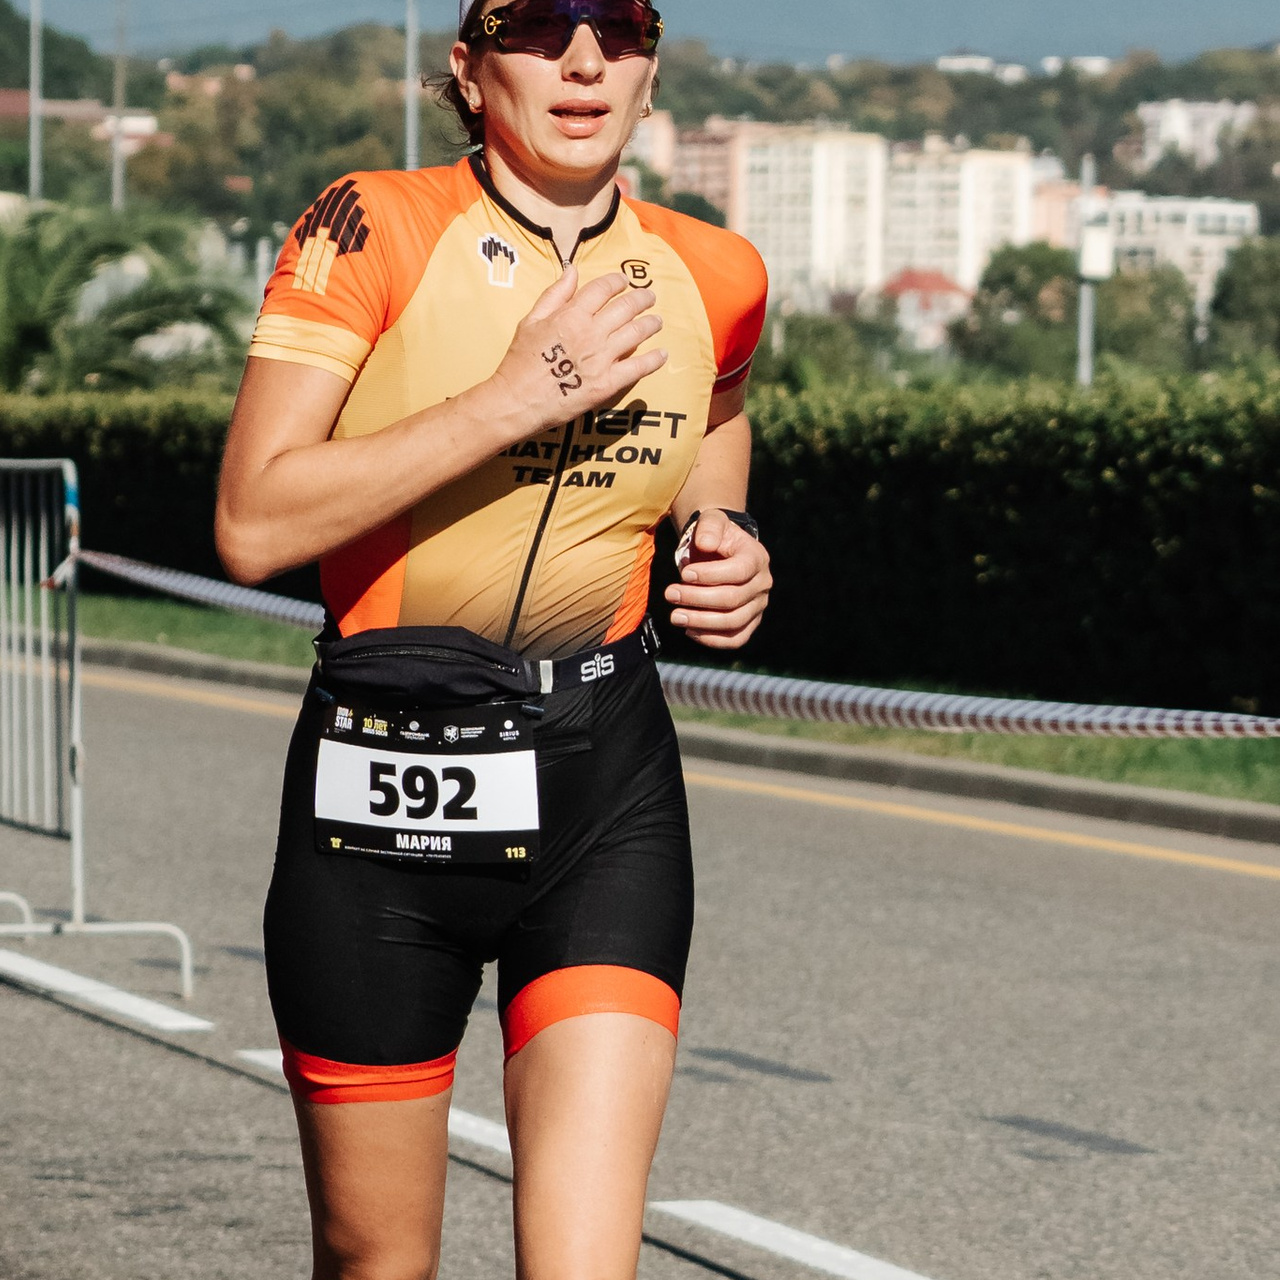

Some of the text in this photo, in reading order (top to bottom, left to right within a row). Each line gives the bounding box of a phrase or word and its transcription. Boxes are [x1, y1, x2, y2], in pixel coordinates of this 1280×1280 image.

[541, 342, 582, 397] 592
[498, 440, 662, 465] IATHLON
[512, 466, 616, 489] TEAM
[335, 716, 353, 730] STAR
[363, 718, 373, 728] 10
[370, 760, 478, 820] 592
[395, 832, 452, 851] МАРИЯ
[505, 847, 527, 859] 113
